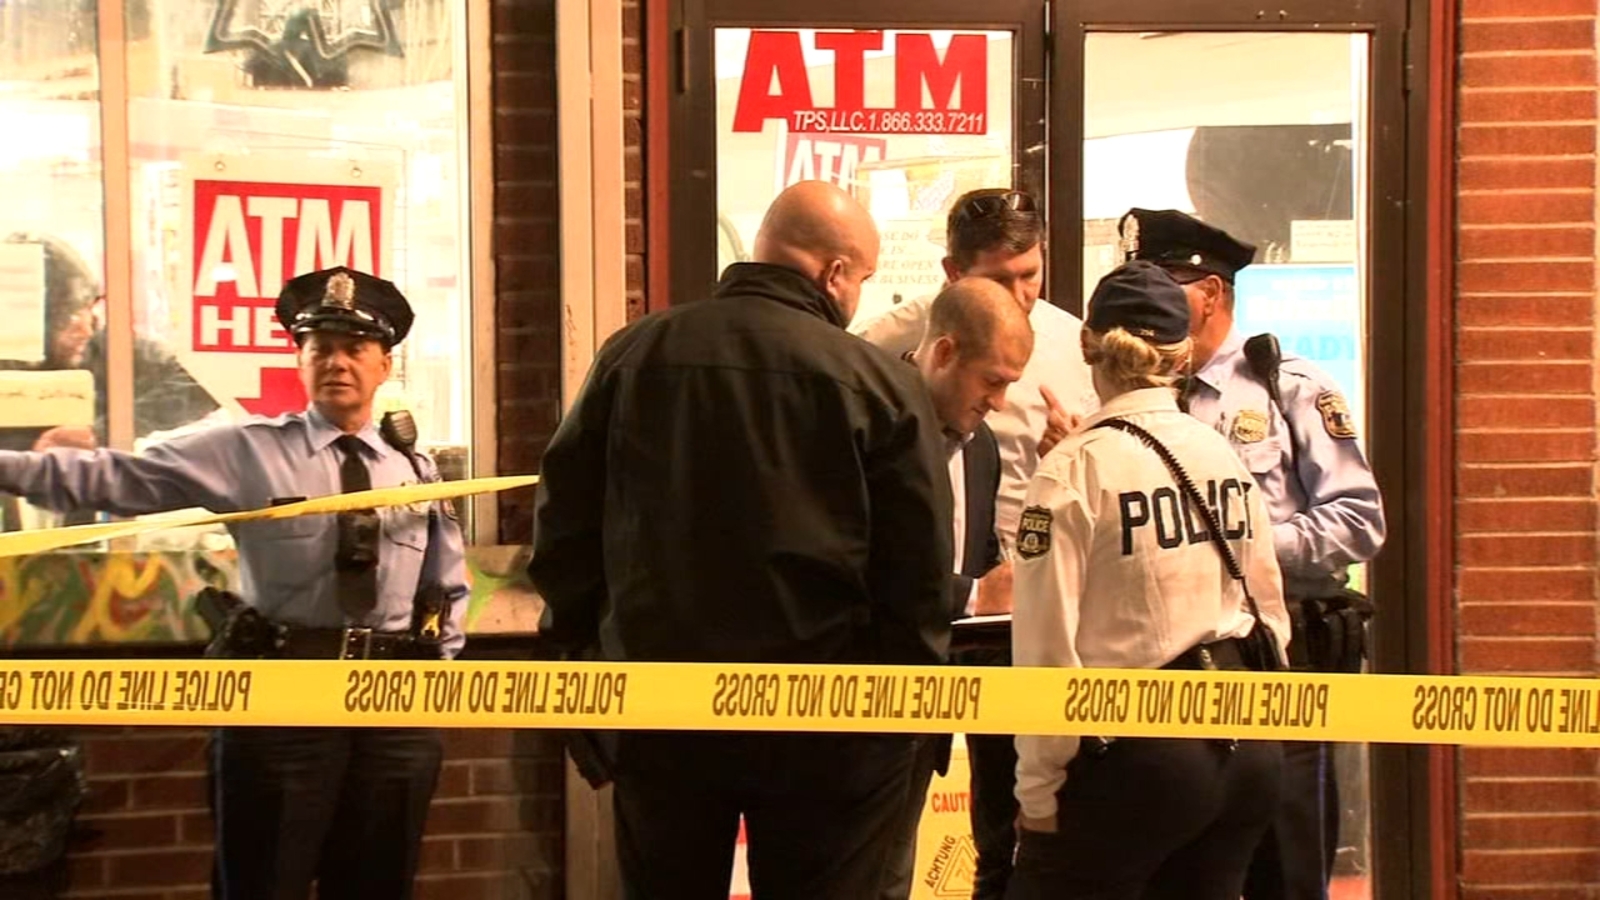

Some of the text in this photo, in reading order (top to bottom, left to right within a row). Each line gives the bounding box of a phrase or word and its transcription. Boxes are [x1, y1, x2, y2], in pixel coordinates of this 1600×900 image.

[732, 31, 987, 134] ATM
[195, 194, 375, 299] ATM
[201, 305, 294, 347] HE
[1022, 517, 1049, 532] POLICE
[931, 792, 971, 813] CAUT
[924, 834, 956, 889] ACHTUNG
